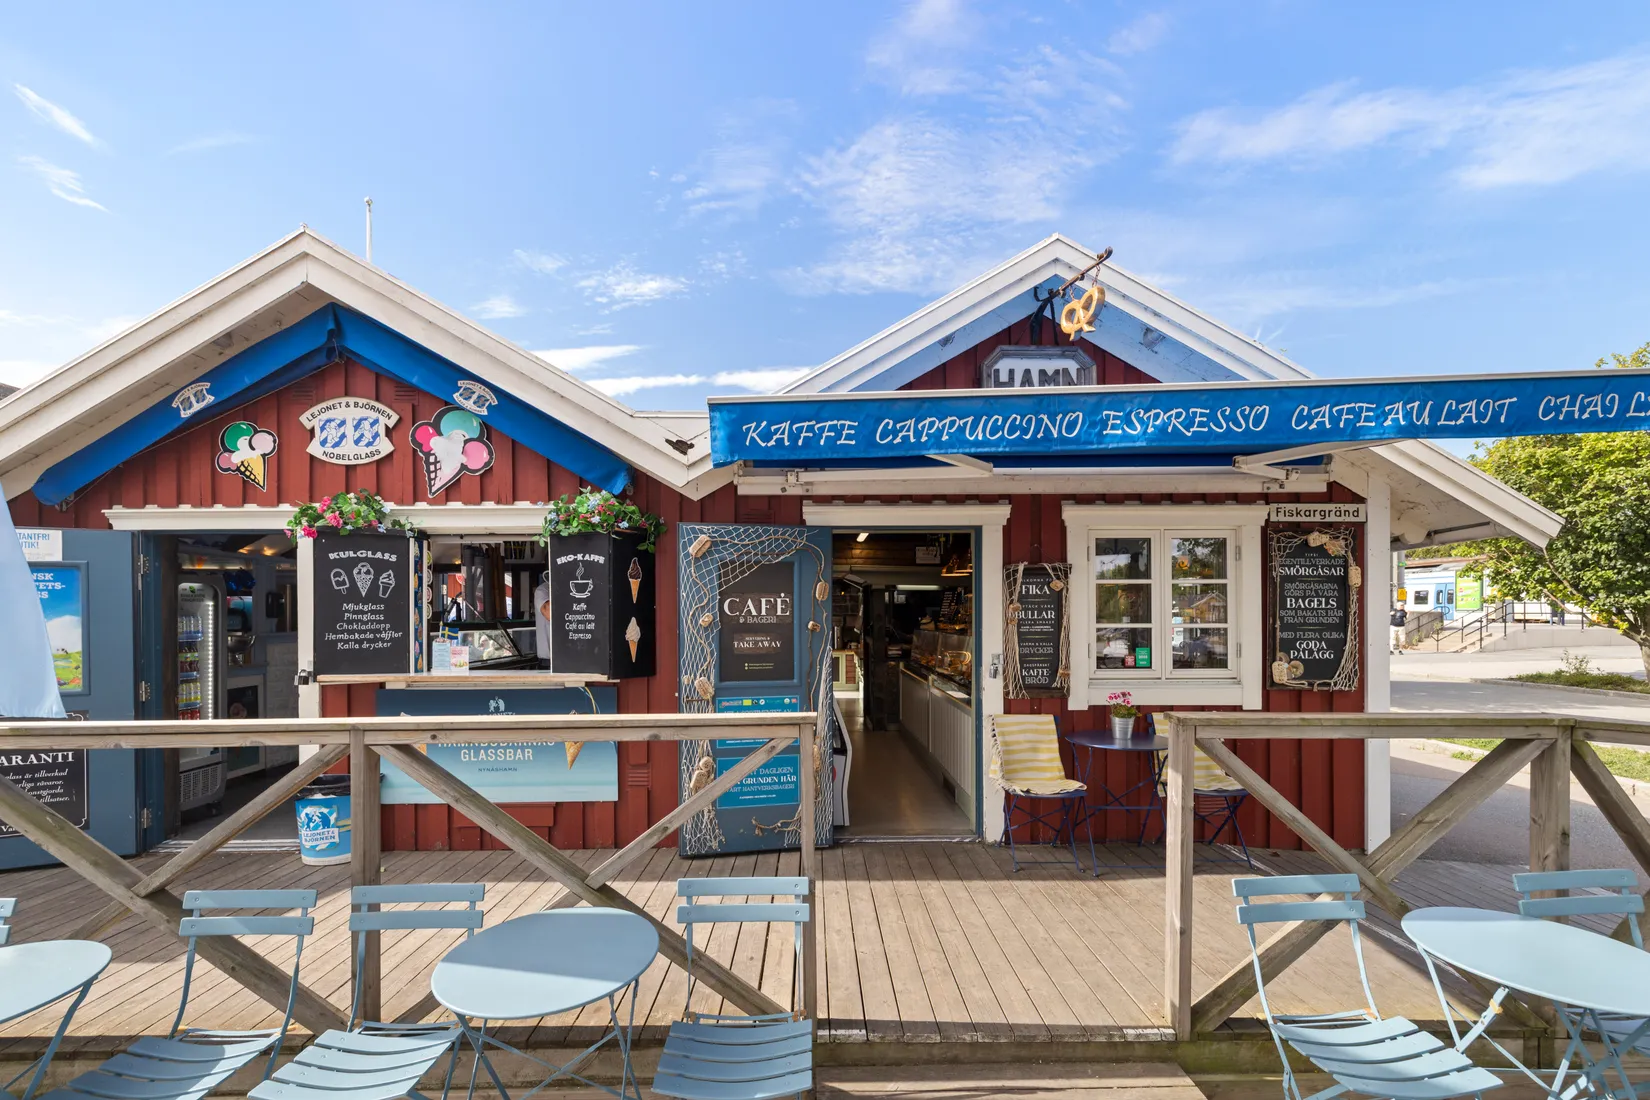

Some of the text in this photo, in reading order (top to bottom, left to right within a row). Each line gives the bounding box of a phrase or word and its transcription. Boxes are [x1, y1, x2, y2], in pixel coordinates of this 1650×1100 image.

[306, 401, 342, 423] LEJONET
[353, 401, 393, 420] BJÖRNEN
[742, 391, 1650, 447] KAFFE CAPPUCCINO ESPRESSO CAFE AU LAIT CHAI L
[322, 448, 382, 461] NOBELGLASS
[1275, 506, 1360, 520] Fiskargränd
[18, 532, 50, 541] TANTFRI
[328, 550, 398, 562] KULGLASS
[556, 553, 605, 565] EKO-KAFFE
[1279, 565, 1345, 576] SMÖRGÅSAR
[1021, 584, 1050, 595] FIKA
[1284, 581, 1338, 590] SMÖRGÅSARNA
[1284, 588, 1339, 597] GÖRS PÅ VÅRA
[342, 603, 385, 612] Mjukglass
[572, 602, 587, 612] Kaffe
[723, 592, 790, 616] CAFÉ
[1286, 597, 1337, 609] BAGELS
[344, 612, 385, 621] Pinnglass
[564, 612, 595, 622] Cappuccino
[1015, 610, 1055, 620] BULLAR
[1280, 608, 1343, 617] SOM BAKATS HÄR
[747, 616, 777, 624] BAGERI
[1284, 615, 1340, 624] FRÅN GRUNDEN
[336, 622, 391, 631] Chokladdopp
[325, 632, 374, 641] Hembakade
[568, 631, 592, 641] Espresso
[1322, 631, 1345, 639] OLIKA
[337, 640, 392, 650] Kalla drycker
[757, 640, 782, 648] AWAY
[1296, 640, 1327, 650] GODA
[1290, 648, 1334, 660] PÅLÄGG
[1025, 675, 1049, 684] BRÖD
[461, 748, 533, 761] GLASSBAR
[34, 768, 69, 778] tillverkad
[760, 766, 794, 775] DAGLIGEN
[742, 776, 779, 785] GRUNDEN
[781, 774, 797, 783] HÄR
[28, 786, 64, 797] onstgjorda
[303, 830, 330, 838] LEJONET
[304, 835, 336, 843] BJÖRNEN
